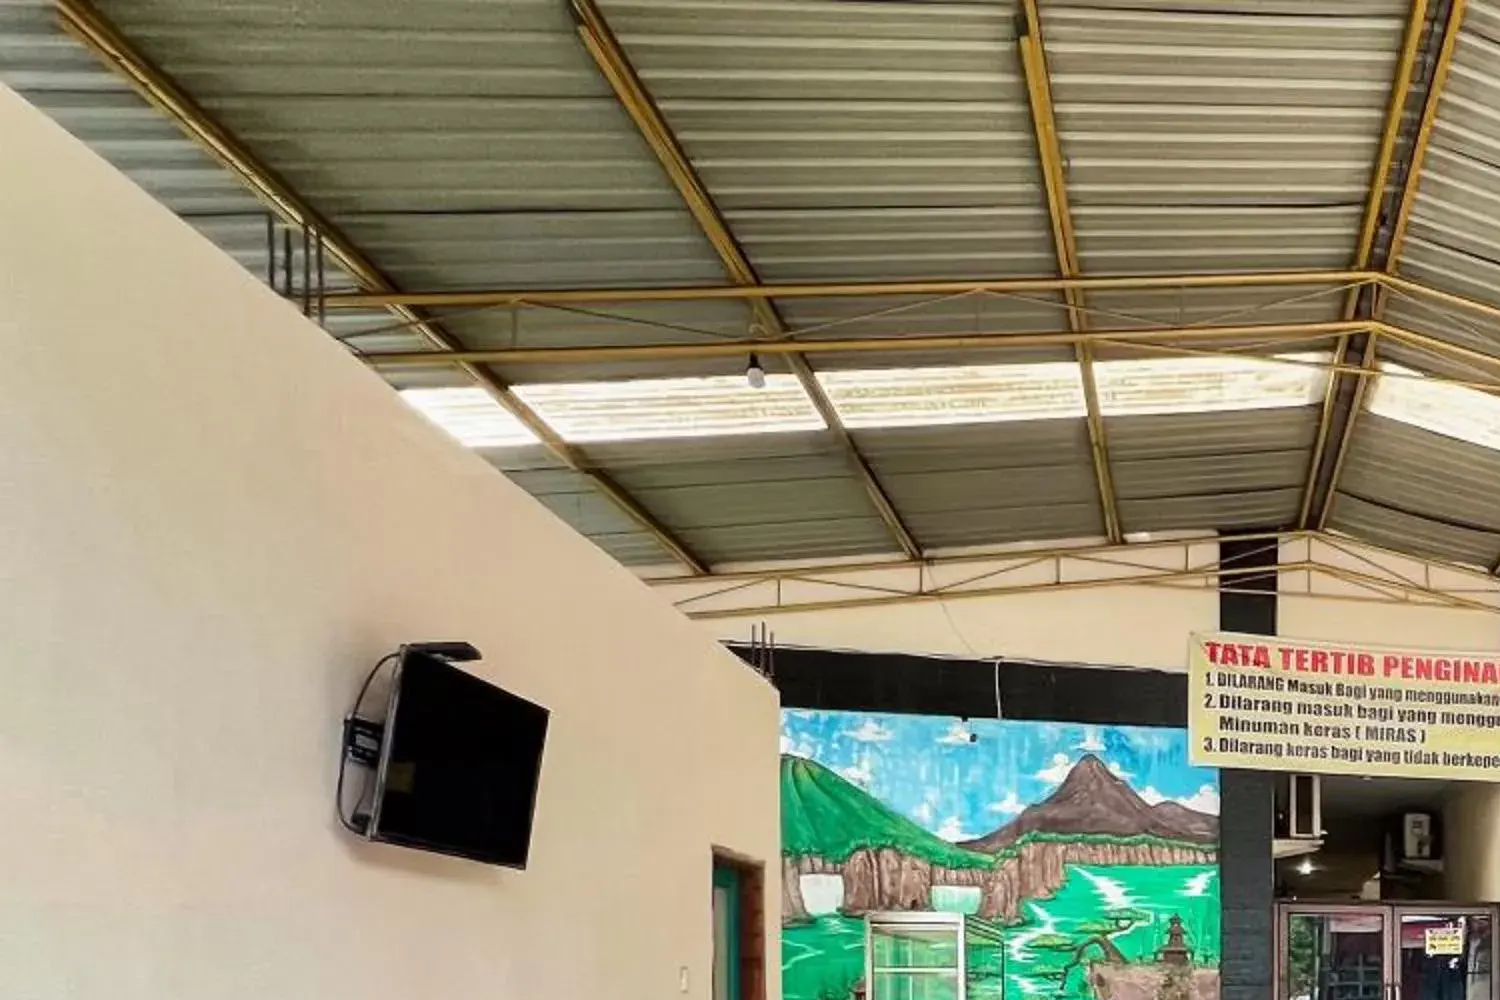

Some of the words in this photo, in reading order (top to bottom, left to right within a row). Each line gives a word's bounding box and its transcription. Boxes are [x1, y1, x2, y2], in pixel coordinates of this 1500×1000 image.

[1205, 642, 1271, 668] TATA
[1278, 648, 1375, 676] TERTIB
[1205, 672, 1215, 686] 1.
[1217, 672, 1284, 692] DILARANG
[1287, 679, 1333, 697] Masuk
[1336, 683, 1367, 700] Bagi
[1369, 687, 1402, 702] yang
[1405, 689, 1499, 706] menggunakan
[1204, 693, 1217, 708] 2.
[1219, 694, 1293, 714] Dilarang
[1297, 702, 1353, 718] masuk
[1357, 704, 1393, 722] bagi
[1398, 709, 1437, 724] yang
[1219, 715, 1300, 735] Minuman
[1303, 722, 1351, 739] keras
[1365, 725, 1417, 742] MIRAS
[1203, 736, 1217, 752] 3.
[1219, 738, 1283, 757] Dilarang
[1286, 743, 1328, 758] keras
[1331, 746, 1363, 762] bagi
[1365, 749, 1401, 764] yang
[1403, 750, 1439, 765] tidak
